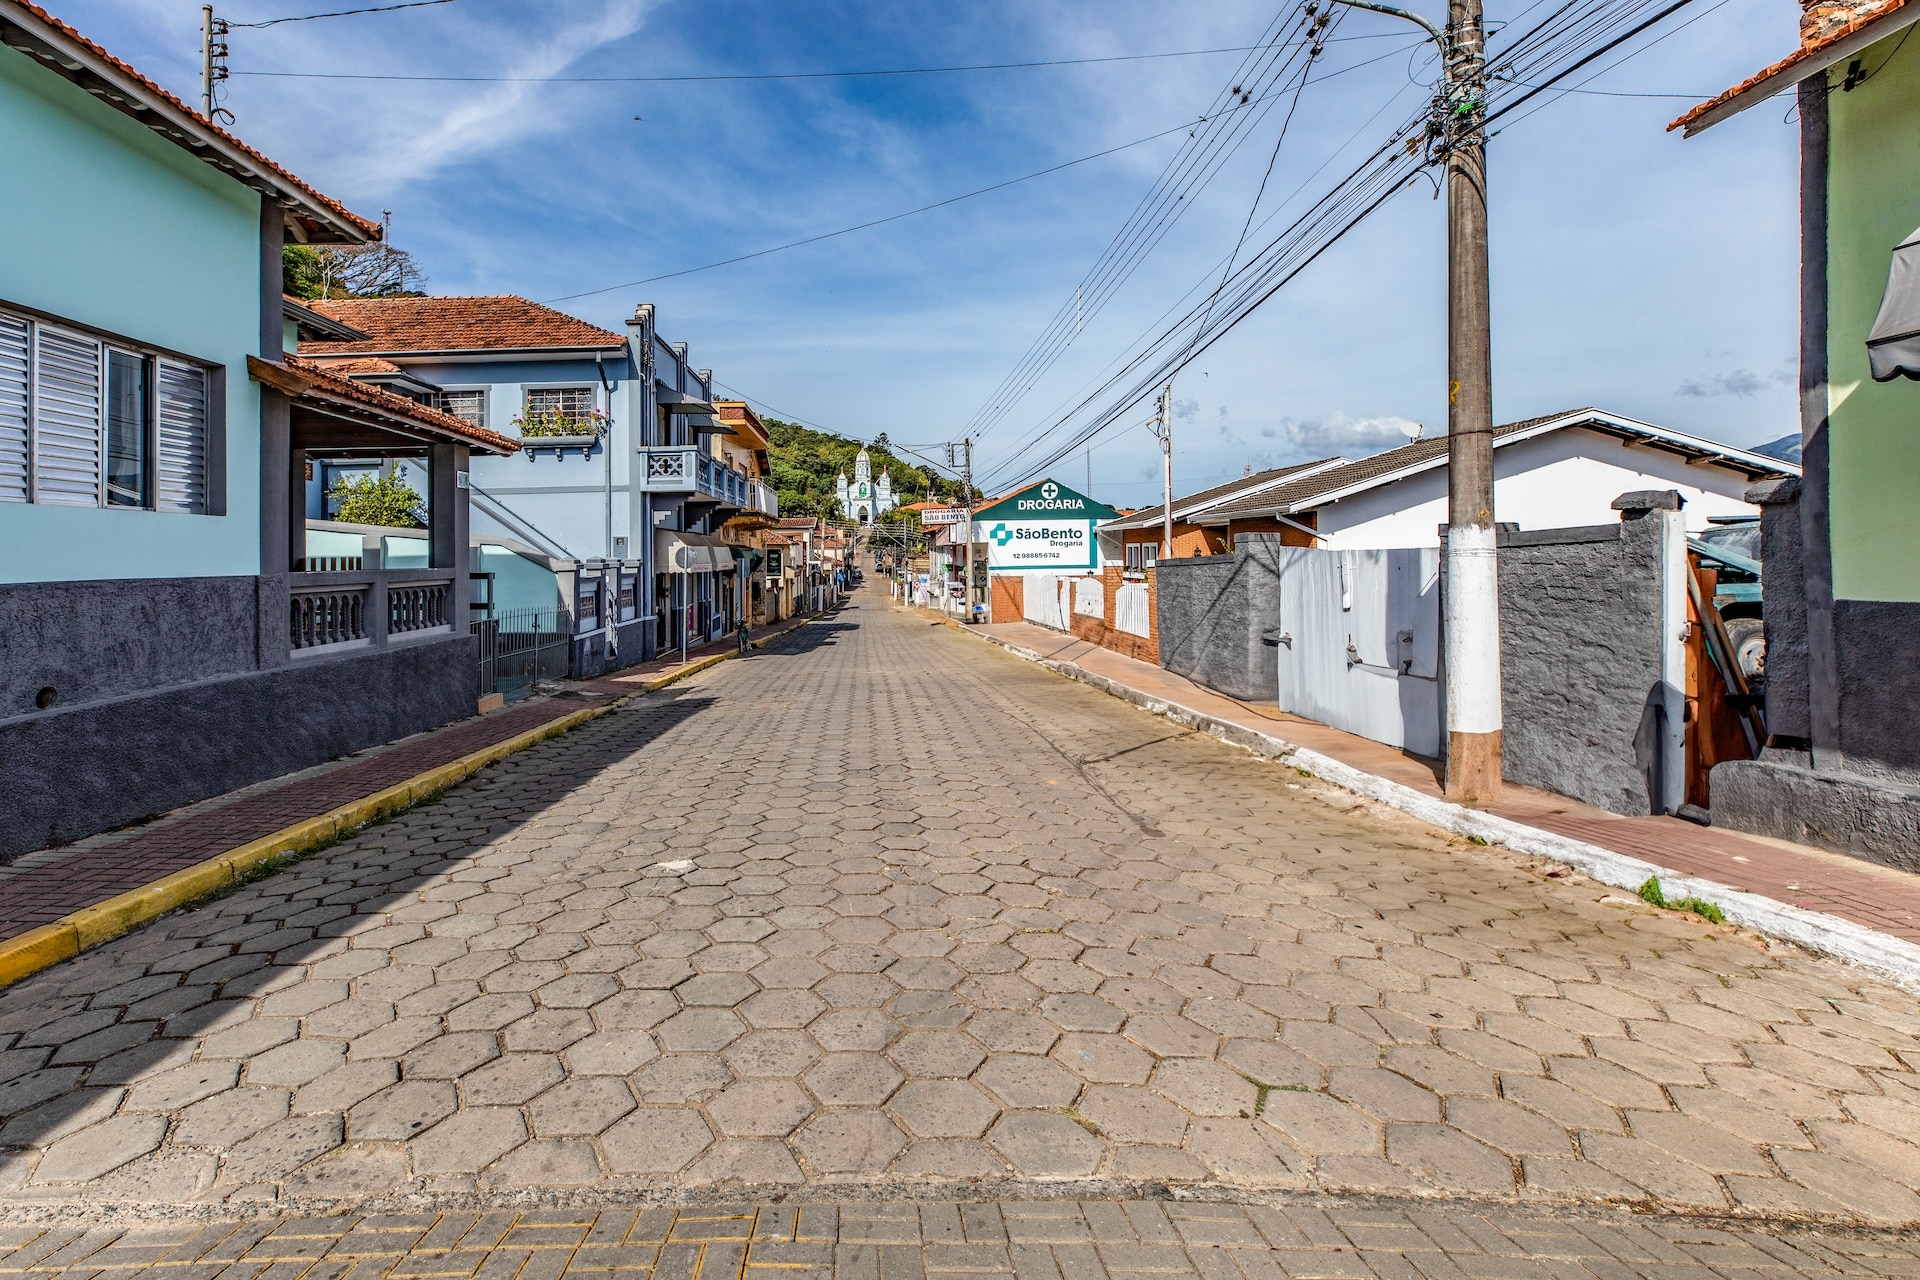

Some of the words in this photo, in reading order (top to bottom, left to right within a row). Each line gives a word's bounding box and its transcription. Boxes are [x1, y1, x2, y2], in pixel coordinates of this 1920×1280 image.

[1017, 499, 1085, 510] DROGARIA
[1016, 528, 1083, 540] SãoBento
[1050, 540, 1083, 548] Drogaria
